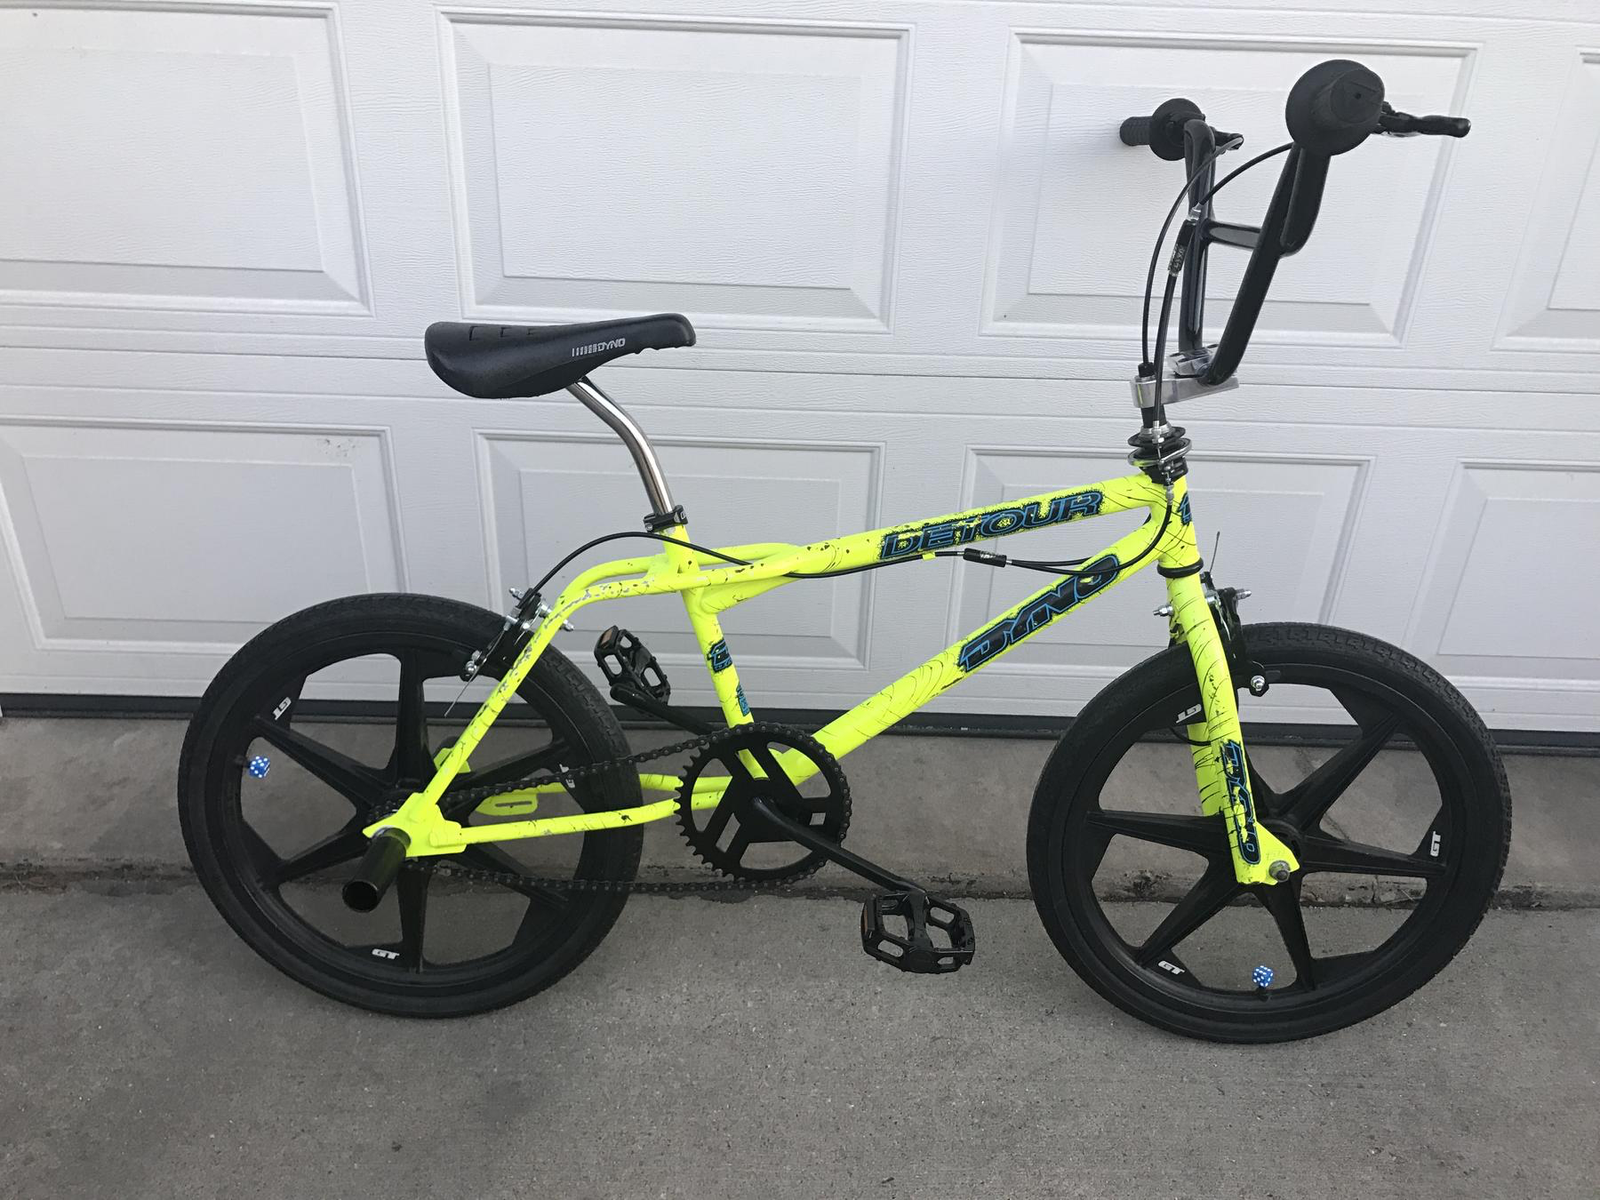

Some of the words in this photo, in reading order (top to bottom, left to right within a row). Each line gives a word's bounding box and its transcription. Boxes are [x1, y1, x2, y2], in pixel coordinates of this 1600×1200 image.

[598, 338, 626, 352] DYNO
[880, 491, 1103, 559] DETOUR
[959, 553, 1120, 672] DYNO
[272, 696, 292, 720] GT
[1175, 703, 1202, 724] GT
[1430, 830, 1442, 857] GT
[371, 948, 400, 960] GT
[1157, 960, 1185, 975] GT
